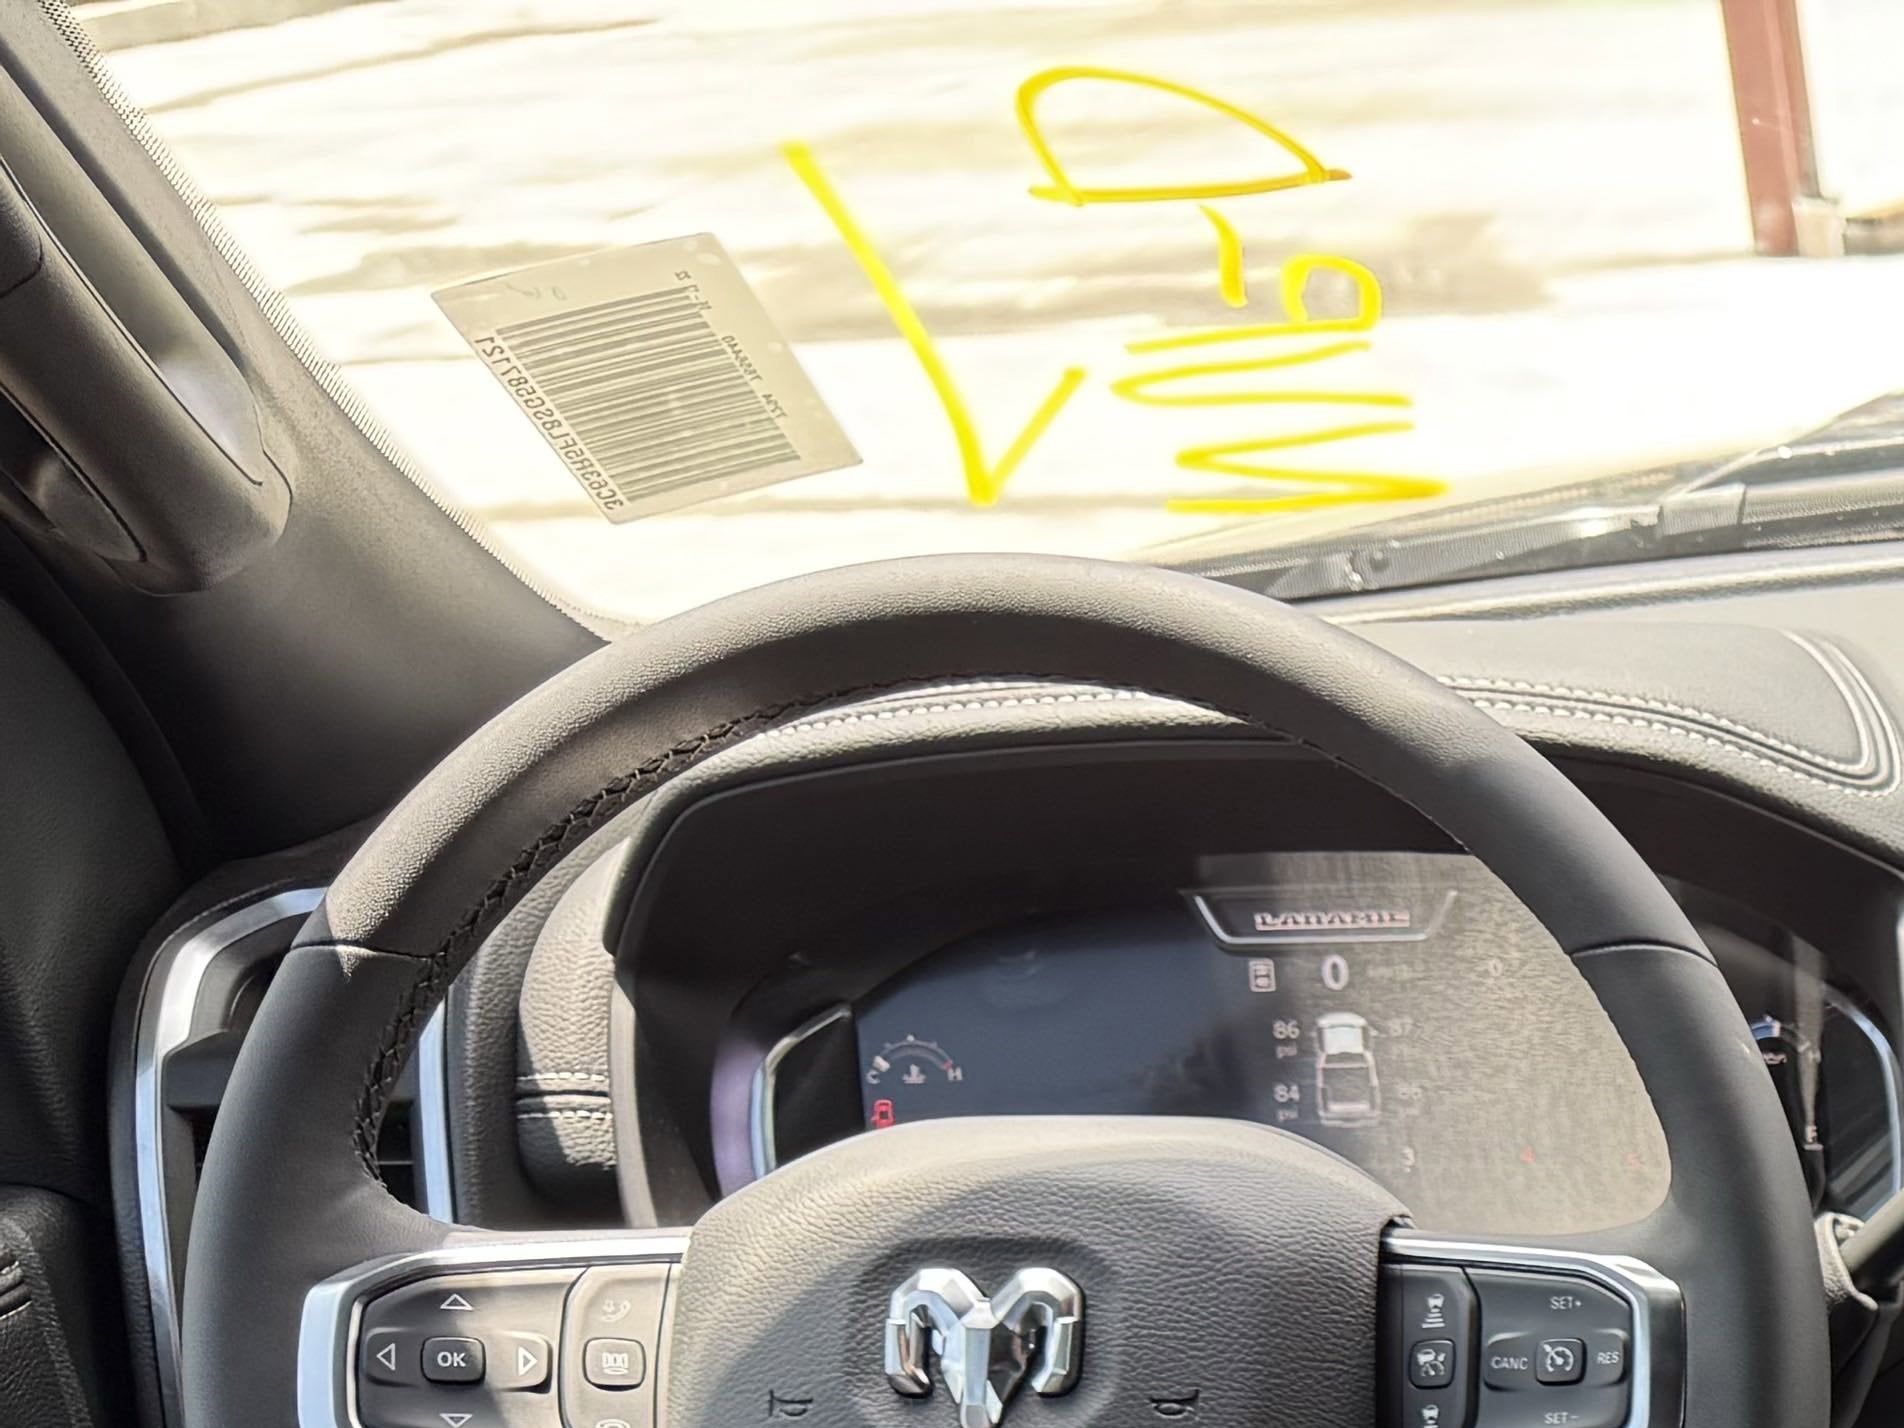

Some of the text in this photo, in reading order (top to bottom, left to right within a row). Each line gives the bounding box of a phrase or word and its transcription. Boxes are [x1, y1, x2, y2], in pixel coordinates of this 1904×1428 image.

[1272, 1020, 1301, 1040] 86
[436, 1351, 467, 1368] OK
[1490, 1356, 1529, 1371] CANC
[1596, 1351, 1620, 1365] RES
